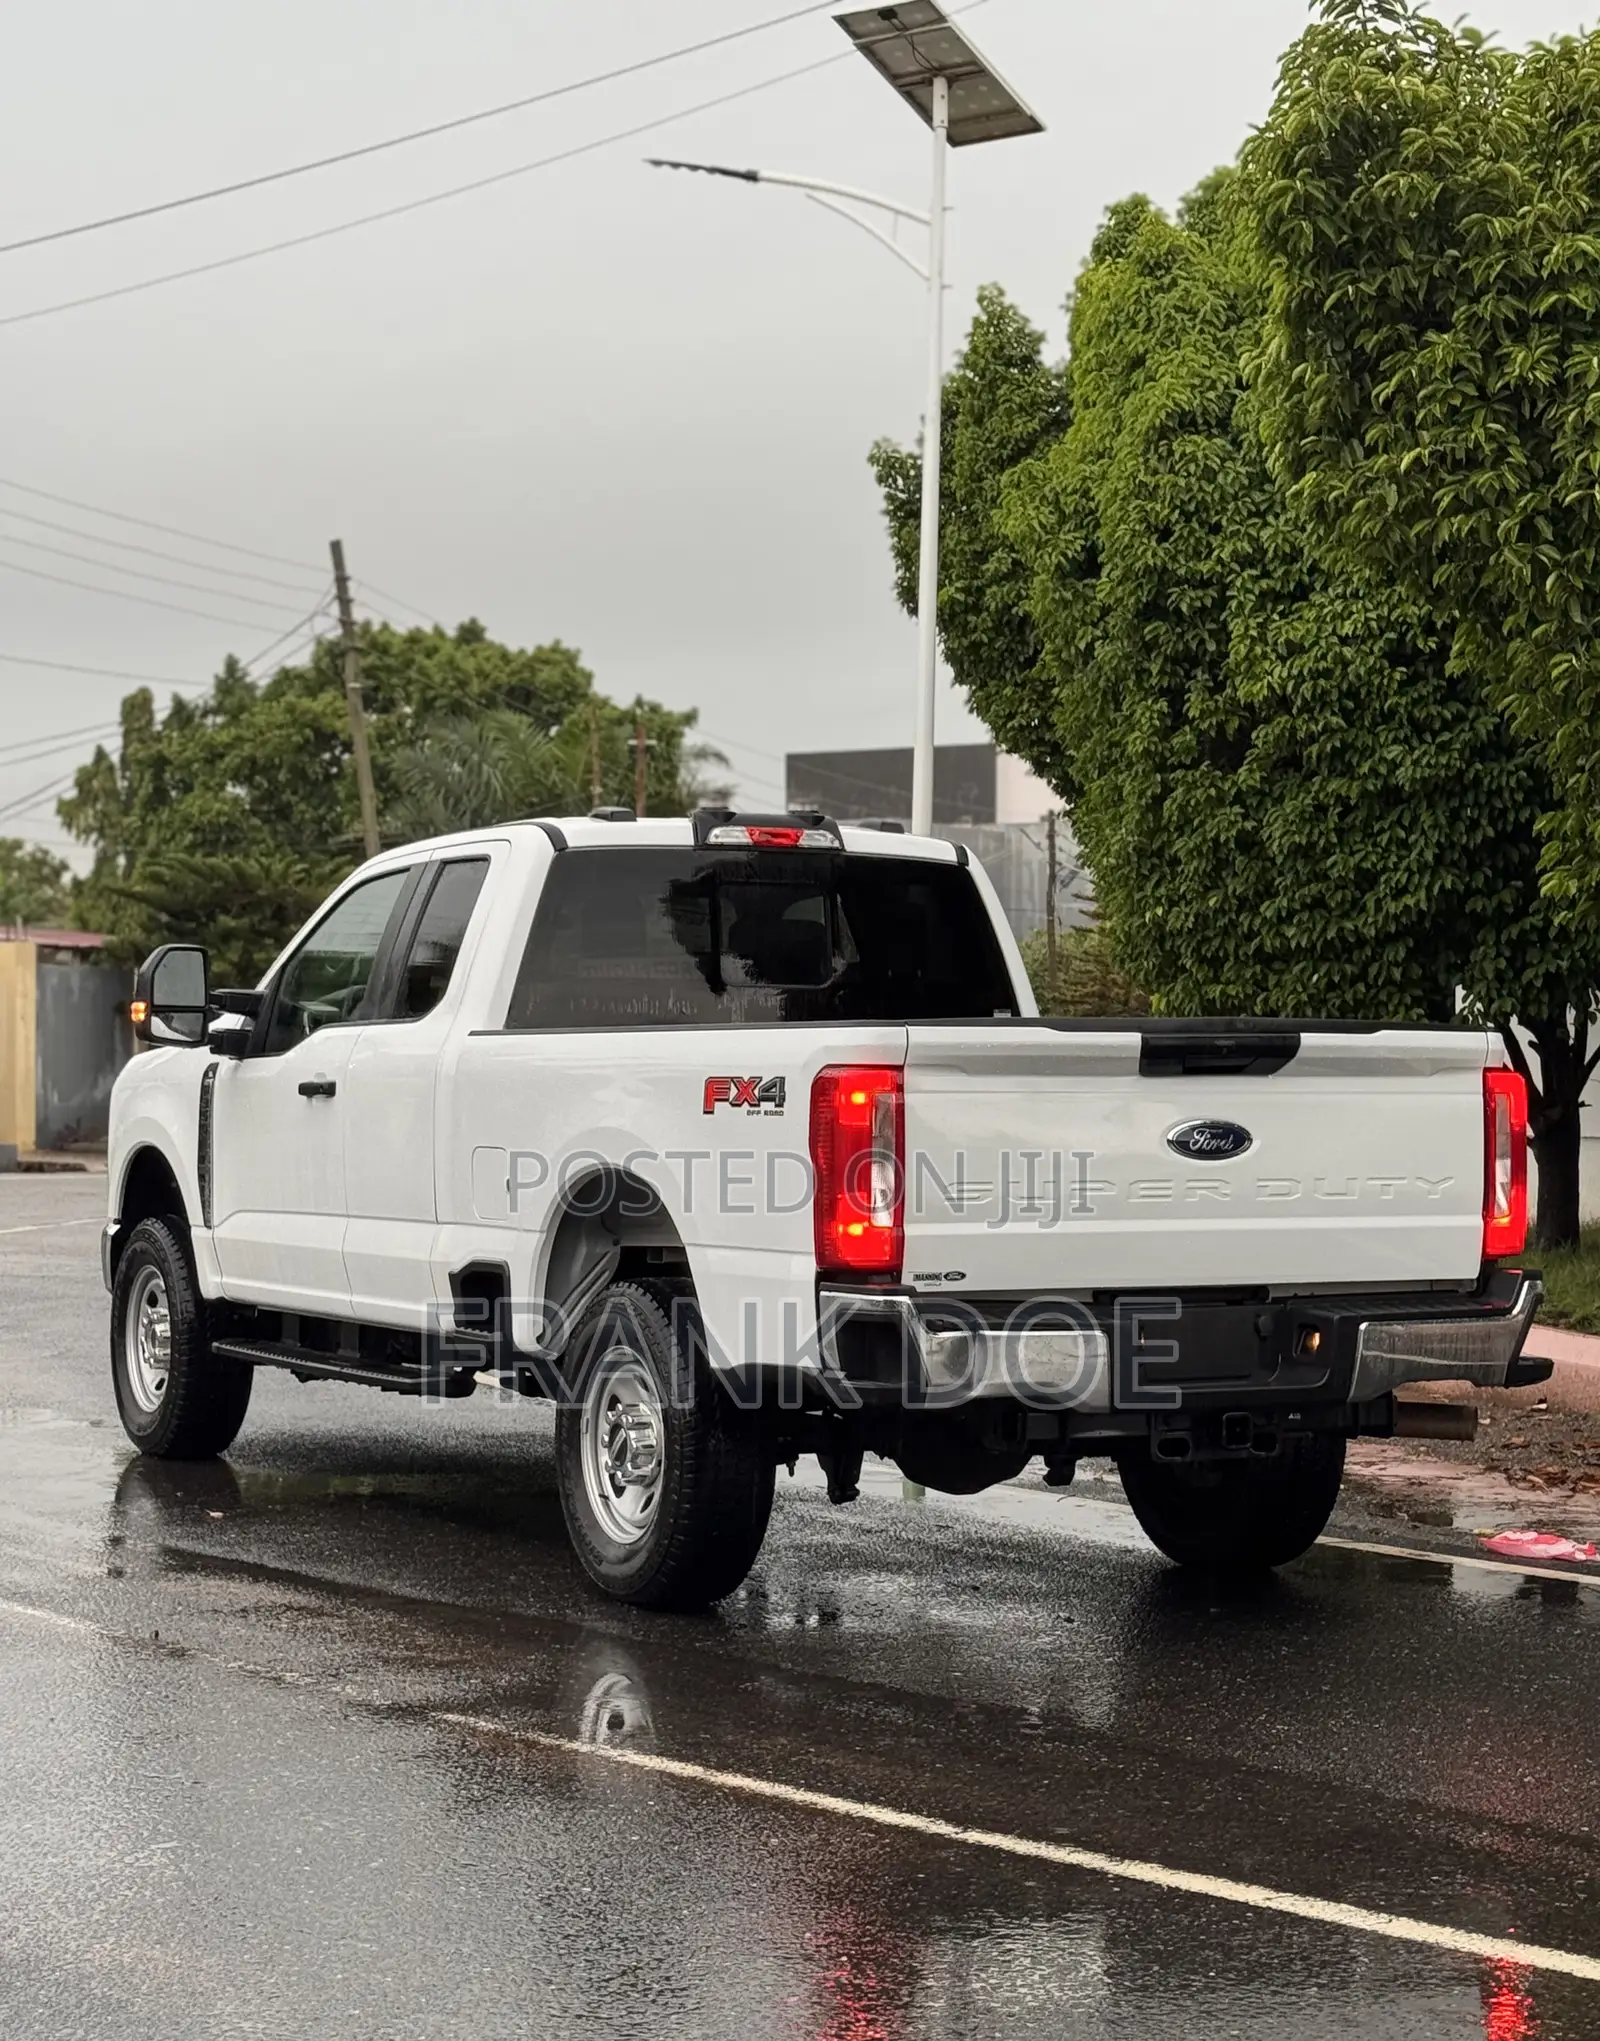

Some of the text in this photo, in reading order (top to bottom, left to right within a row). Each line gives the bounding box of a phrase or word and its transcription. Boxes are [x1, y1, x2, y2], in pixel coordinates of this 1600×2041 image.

[703, 1076, 786, 1115] FX4
[1189, 1128, 1234, 1151] Ford
[944, 1176, 1455, 1204] SUPER DUTY
